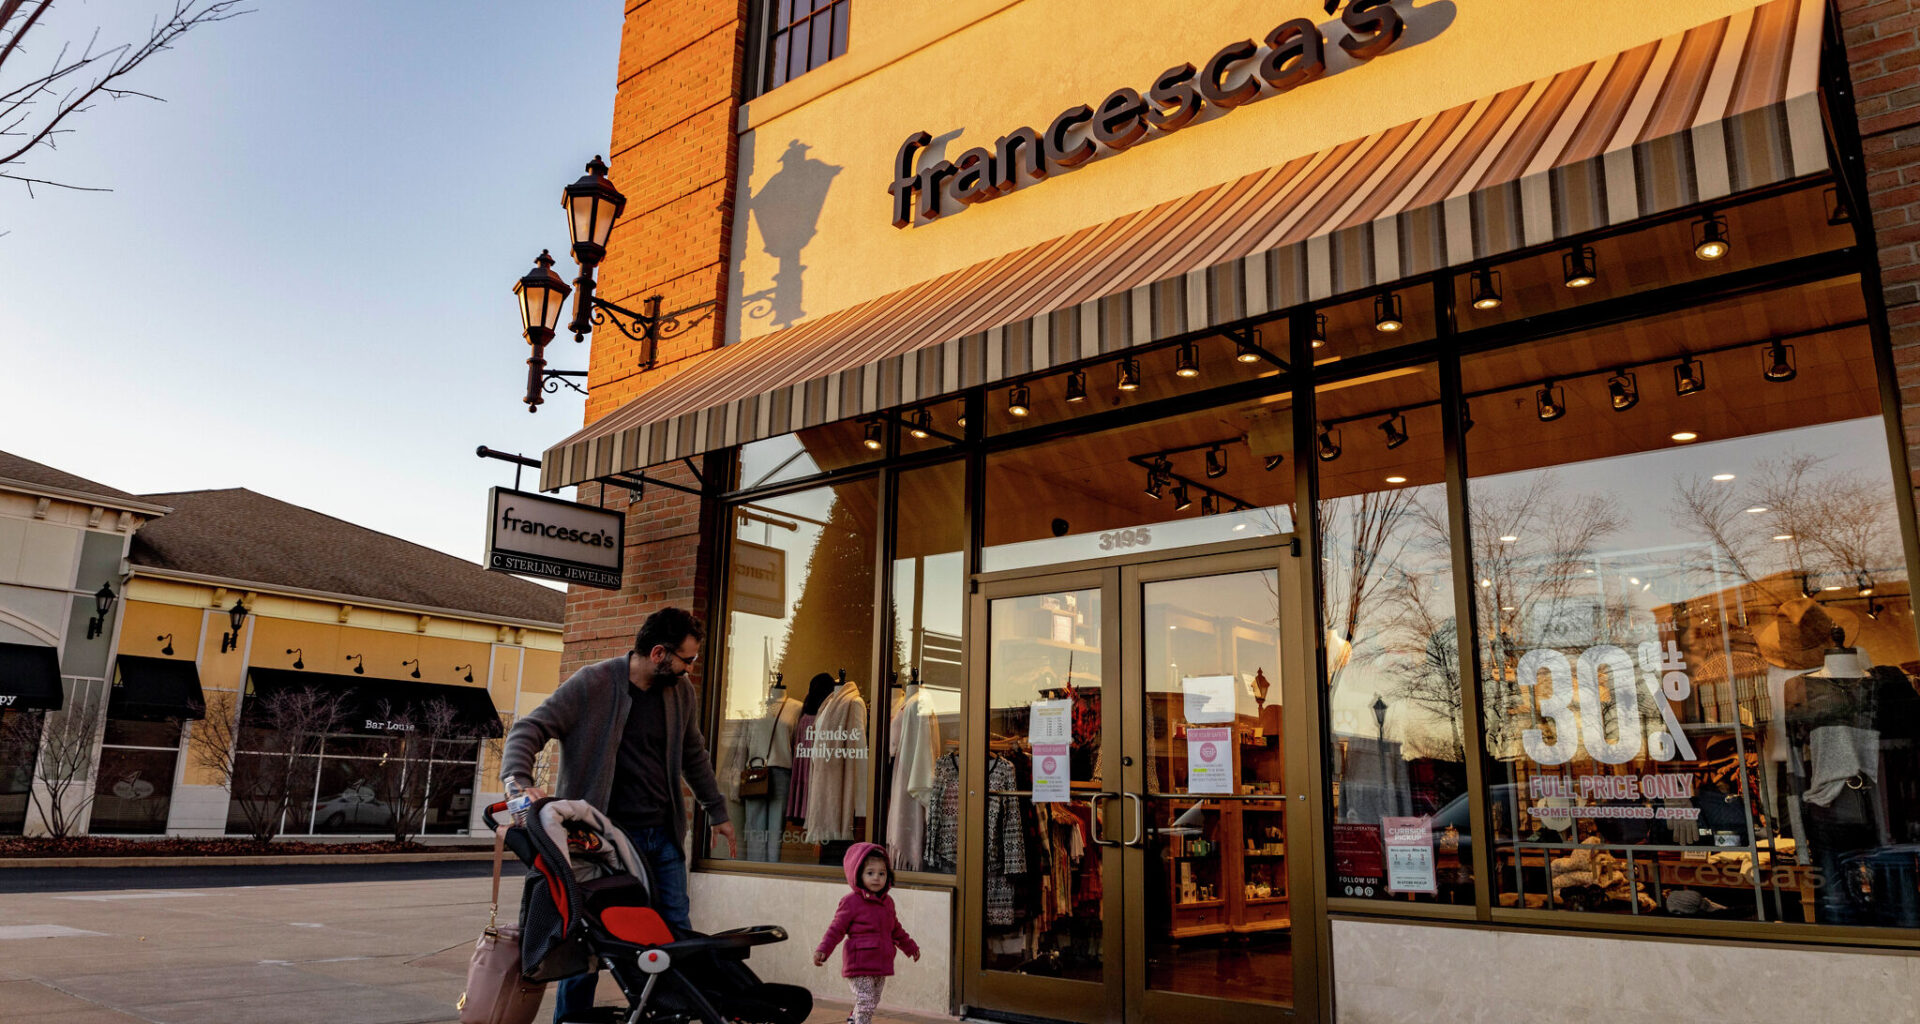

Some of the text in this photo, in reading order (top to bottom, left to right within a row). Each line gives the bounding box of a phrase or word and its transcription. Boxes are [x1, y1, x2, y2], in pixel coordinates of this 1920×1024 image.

[889, 0, 1406, 229] francesca's
[502, 507, 615, 548] francesca's
[1098, 527, 1152, 550] 3195
[493, 555, 620, 585] C STERLING JEWELERS
[365, 719, 415, 732] Bar Louie
[805, 726, 861, 741] friends &
[796, 743, 869, 762] family event
[1529, 773, 1694, 799] FULL PRICE ONLY
[1571, 807, 1654, 819] EXCLUSIONS
[1655, 807, 1701, 820] APPLY
[1388, 827, 1427, 835] CURBSIDE
[1339, 876, 1365, 884] FOLLOW
